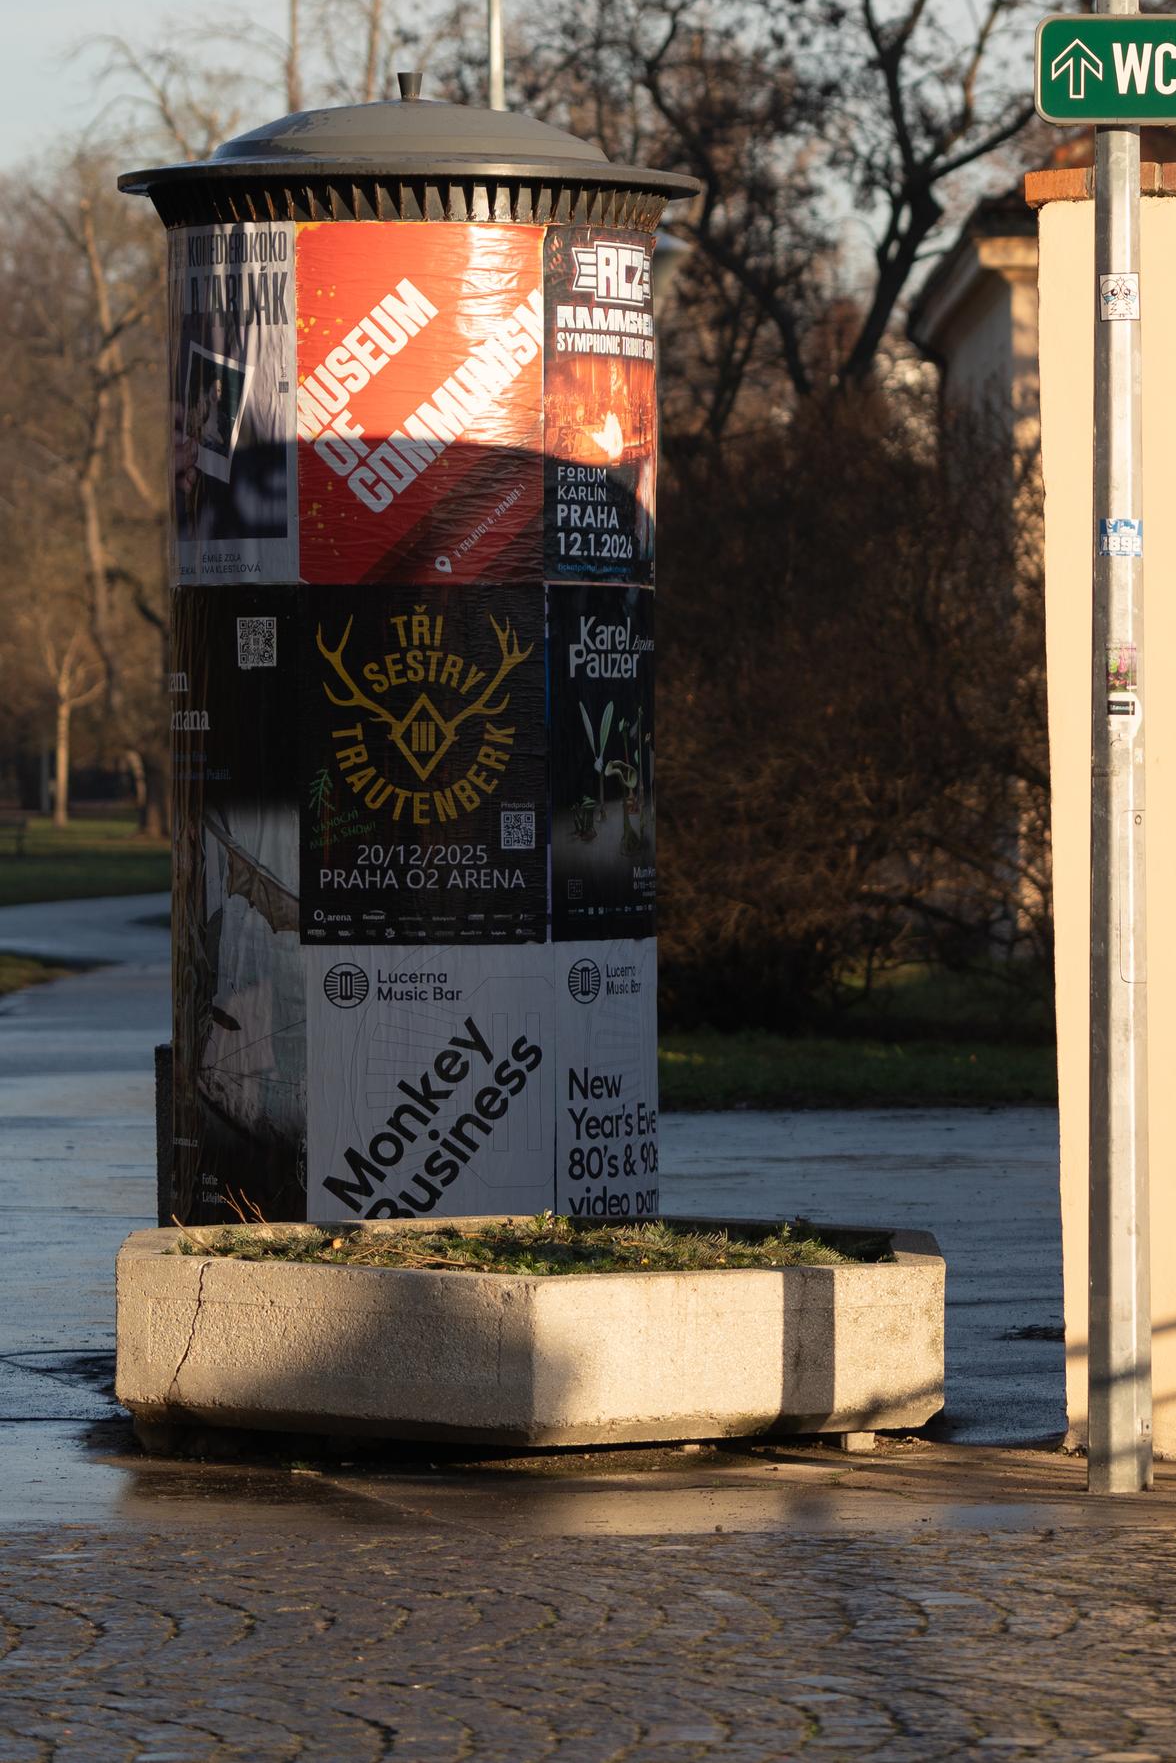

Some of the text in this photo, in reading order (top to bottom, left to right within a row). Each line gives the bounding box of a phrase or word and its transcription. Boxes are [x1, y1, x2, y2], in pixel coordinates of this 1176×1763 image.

[556, 331, 621, 355] SYMPHONIC
[297, 277, 439, 444] MUSEUM
[313, 408, 371, 477] OF
[557, 484, 607, 502] KARLÍN
[556, 503, 620, 529] PRAHA
[556, 531, 633, 559] 12.1.2026
[1102, 535, 1142, 552] 1892
[390, 604, 443, 648] TŘI
[580, 615, 631, 651] Karel
[363, 649, 486, 695] SESTRY
[569, 644, 640, 679] Pauzer
[331, 721, 516, 825] TRAUTENBERK
[356, 844, 488, 868] 20/12/2025
[319, 868, 526, 889] PRAHA O2 ARENA
[327, 913, 352, 922] arena
[377, 969, 448, 984] Lucerna
[606, 979, 641, 995] Music Bar
[377, 986, 463, 1001] Music Bar
[568, 1066, 623, 1101] New
[322, 1016, 494, 1214] Monkey
[567, 1102, 656, 1141] Year's Eve
[567, 1143, 619, 1181] 80's
[622, 1143, 636, 1177] &
[567, 1186, 630, 1216] video
